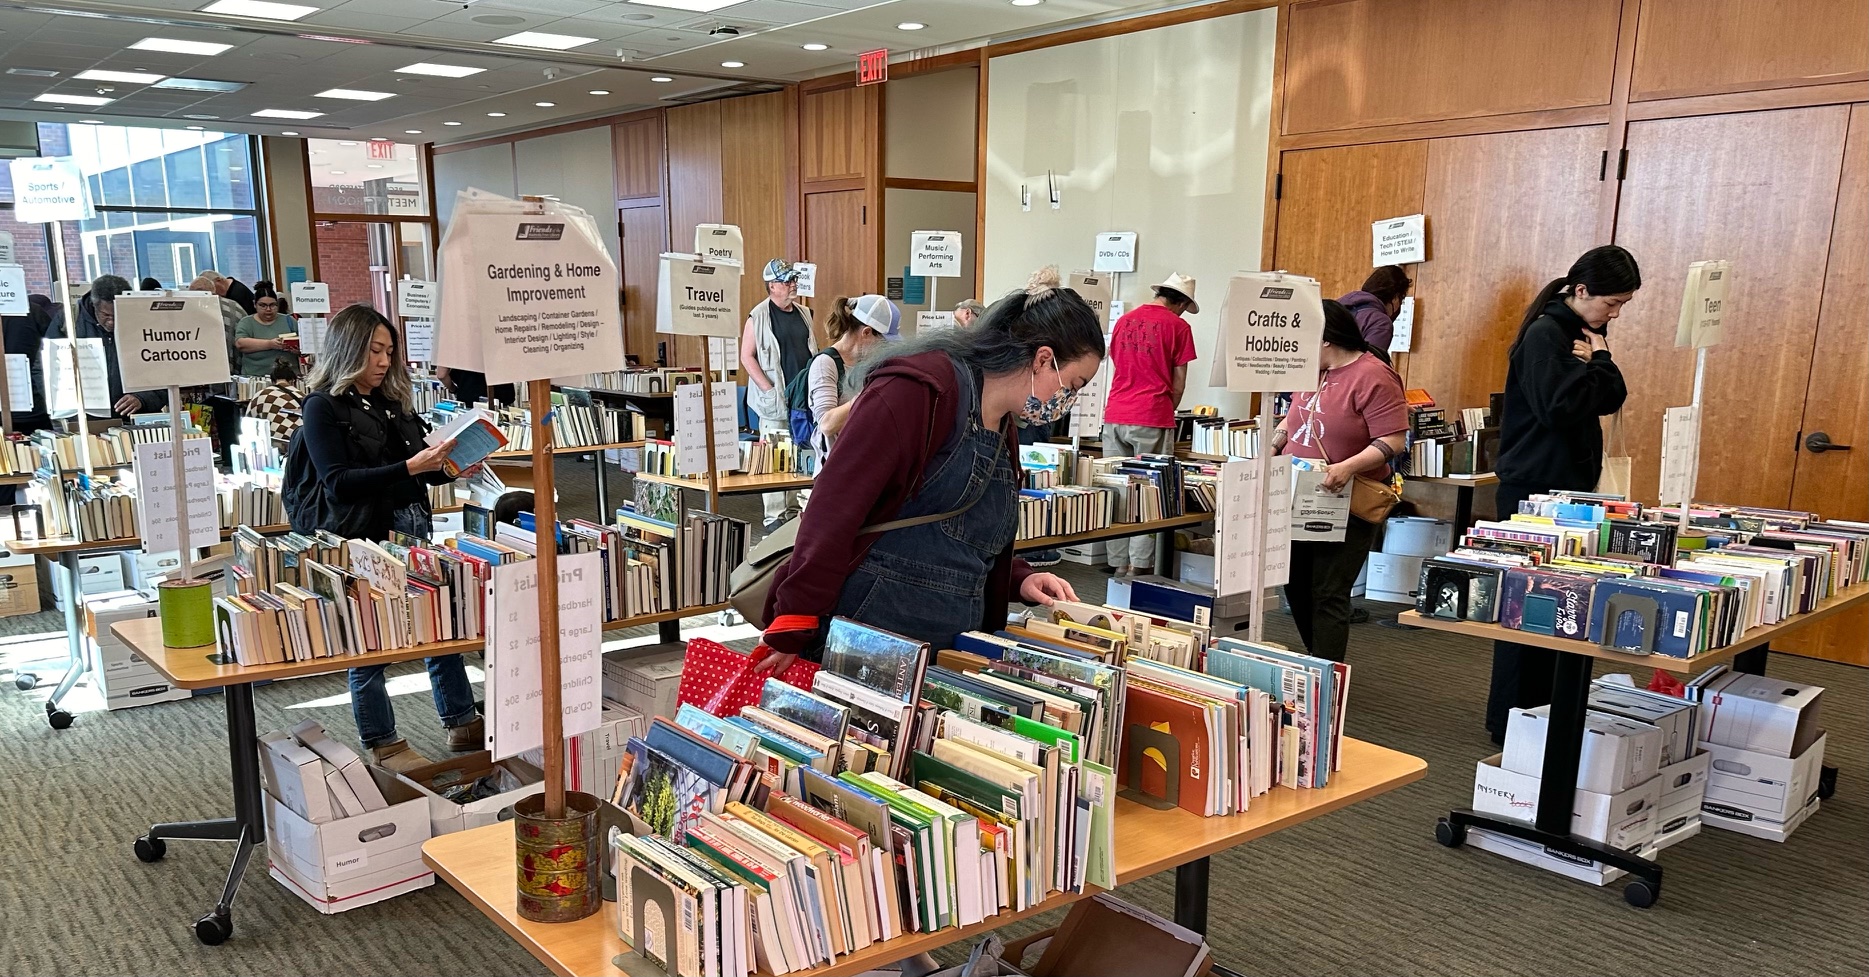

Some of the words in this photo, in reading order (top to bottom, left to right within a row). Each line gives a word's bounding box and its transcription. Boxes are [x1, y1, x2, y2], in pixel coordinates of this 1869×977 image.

[861, 52, 884, 82] EXIT
[371, 141, 394, 159] EXIT
[28, 183, 58, 192] Sports
[1382, 232, 1409, 241] Education
[709, 248, 732, 258] Poetry
[918, 253, 953, 261] Performing
[488, 264, 550, 280] Gardening
[554, 264, 562, 278] &
[566, 263, 600, 278] Home
[507, 286, 586, 304] Improvement
[686, 286, 723, 302] Travel
[1705, 298, 1721, 313] Teen
[498, 313, 537, 322] Landscaping
[542, 311, 570, 320] Container
[570, 310, 594, 318] Gardens
[1248, 310, 1287, 328] Crafts
[1291, 312, 1301, 328] &
[514, 324, 537, 333] Repairs
[542, 322, 576, 330] Remodeling
[580, 320, 599, 328] Design
[142, 329, 191, 341] Humor
[195, 328, 200, 340] /
[504, 336, 526, 344] Interior
[528, 334, 548, 343] Design
[553, 332, 576, 341] Lighting
[580, 330, 594, 339] Style
[522, 345, 549, 354] Cleaning
[554, 342, 584, 352] Organizing
[1246, 335, 1298, 352] Hobbies
[141, 349, 206, 361] Cartoons
[1478, 784, 1515, 801] MYSTERY
[1704, 805, 1734, 816] BANKERS
[1547, 848, 1576, 860] BANKERS
[336, 857, 359, 867] Humor
